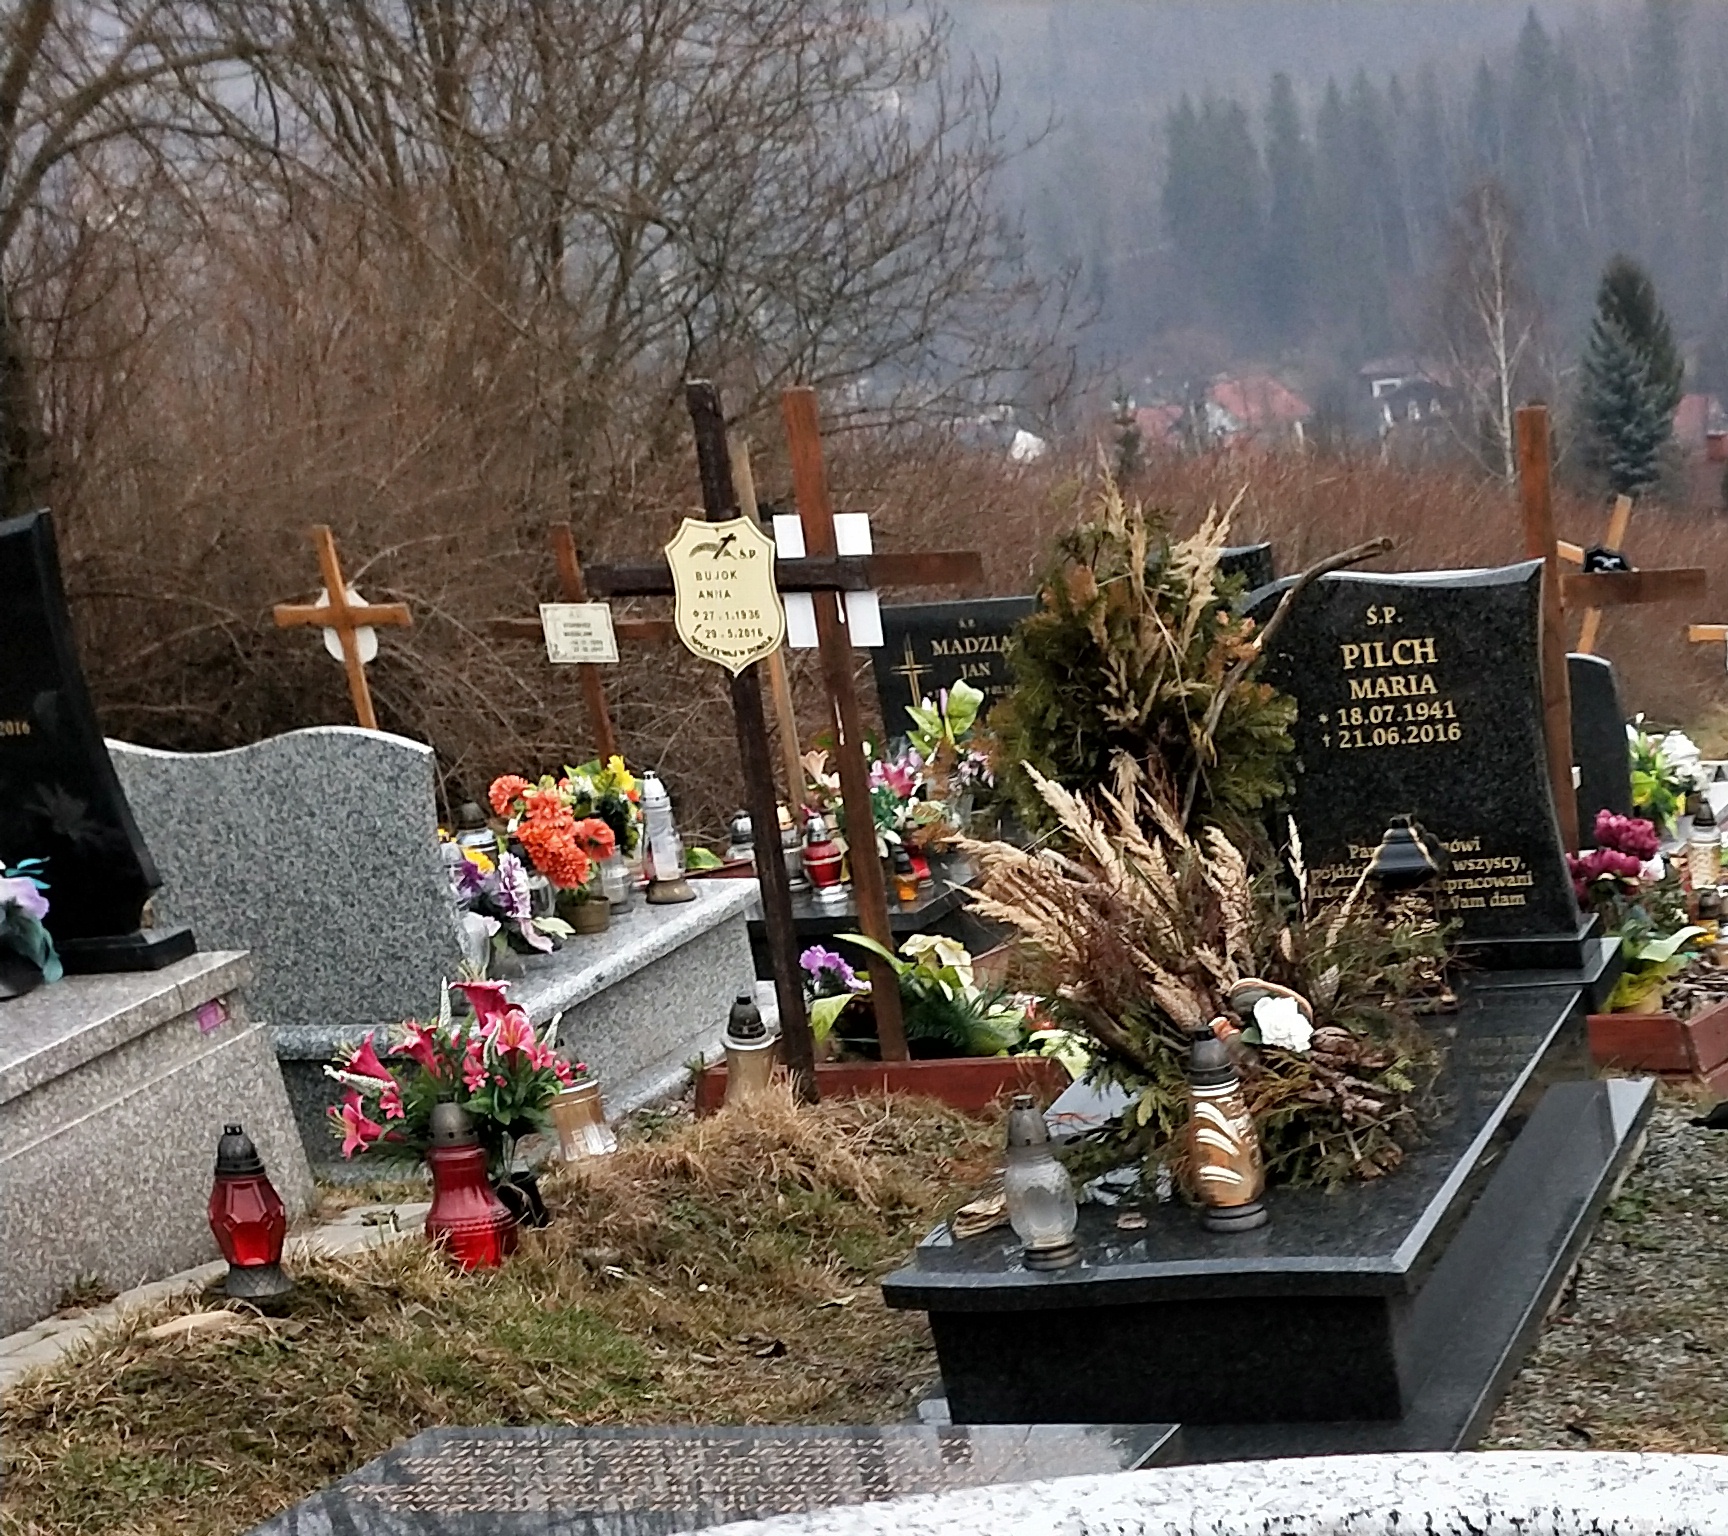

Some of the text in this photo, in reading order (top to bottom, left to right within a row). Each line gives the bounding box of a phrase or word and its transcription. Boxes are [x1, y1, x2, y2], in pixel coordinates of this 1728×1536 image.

[695, 570, 738, 581] BUJOK
[1366, 604, 1403, 625] Ś.P.
[1340, 637, 1439, 670] PILCH
[960, 661, 992, 680] JAN
[1348, 673, 1439, 700] MARIA
[1337, 700, 1457, 726] 18.07.1941
[1338, 722, 1462, 748] 21.06.2016
[1490, 891, 1527, 907] dam
